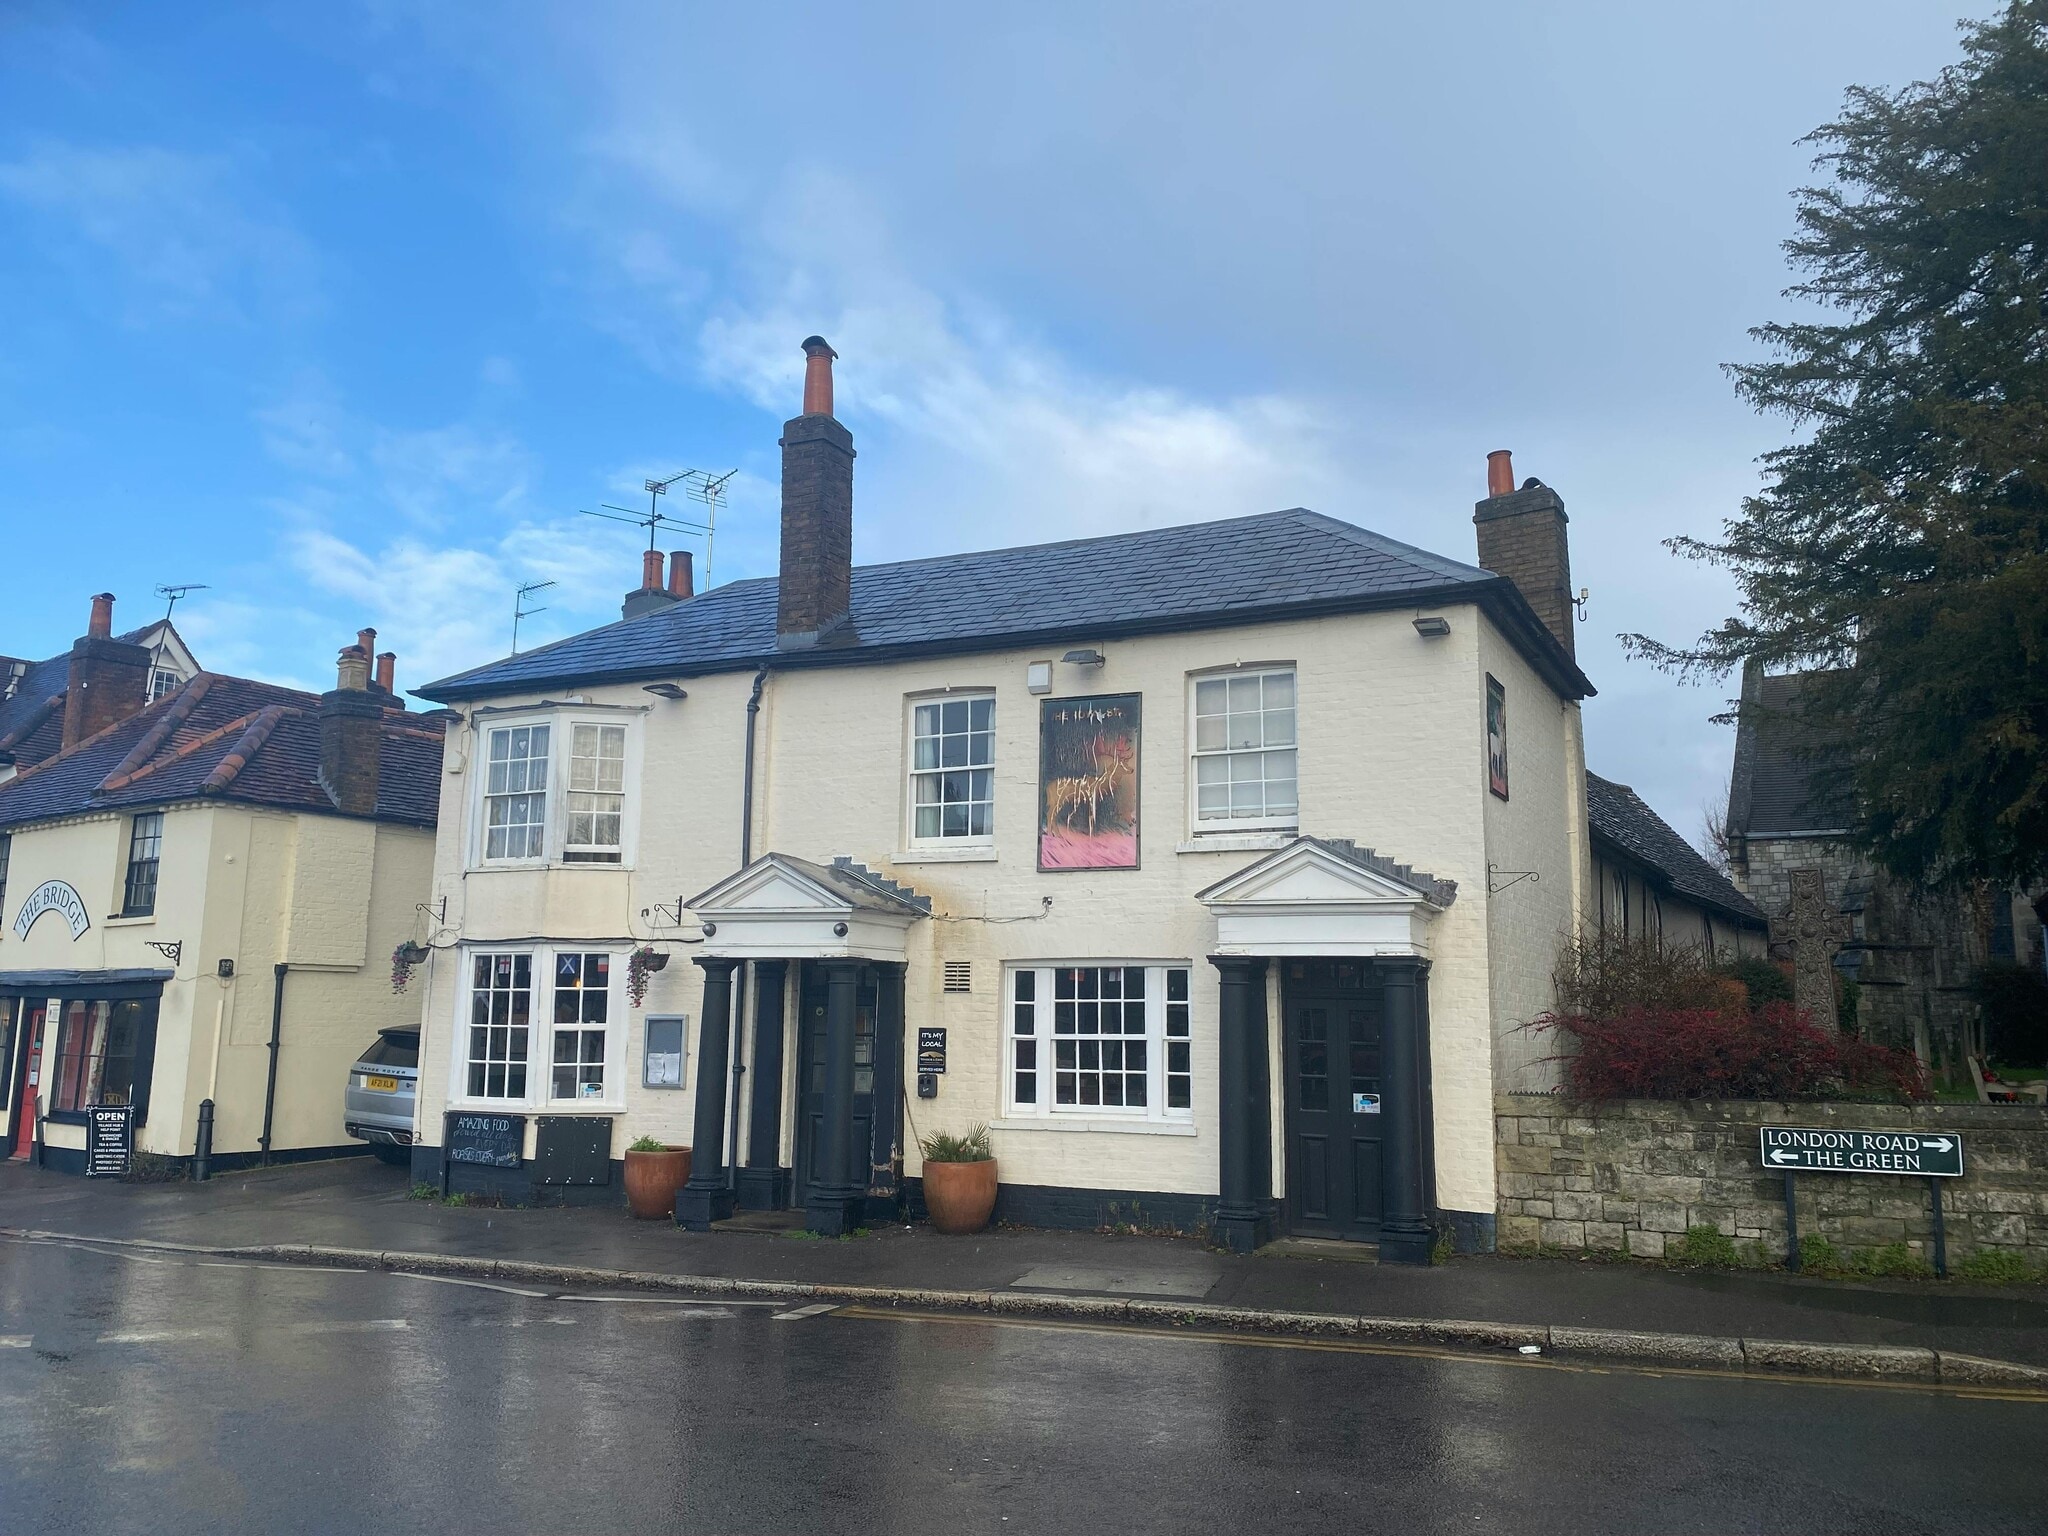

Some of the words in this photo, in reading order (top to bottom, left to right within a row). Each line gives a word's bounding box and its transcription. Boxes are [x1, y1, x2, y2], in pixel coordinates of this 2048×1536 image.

[19, 894, 40, 930] THE
[43, 886, 83, 930] BRIDGE
[933, 1032, 943, 1040] MY
[96, 1112, 125, 1120] OPEN
[457, 1117, 489, 1130] AMAZING
[492, 1119, 510, 1132] FOOD
[1768, 1131, 1853, 1149] LONDON
[1862, 1134, 1920, 1151] ROAD
[1803, 1150, 1844, 1166] THE
[1850, 1152, 1920, 1170] GREEN
